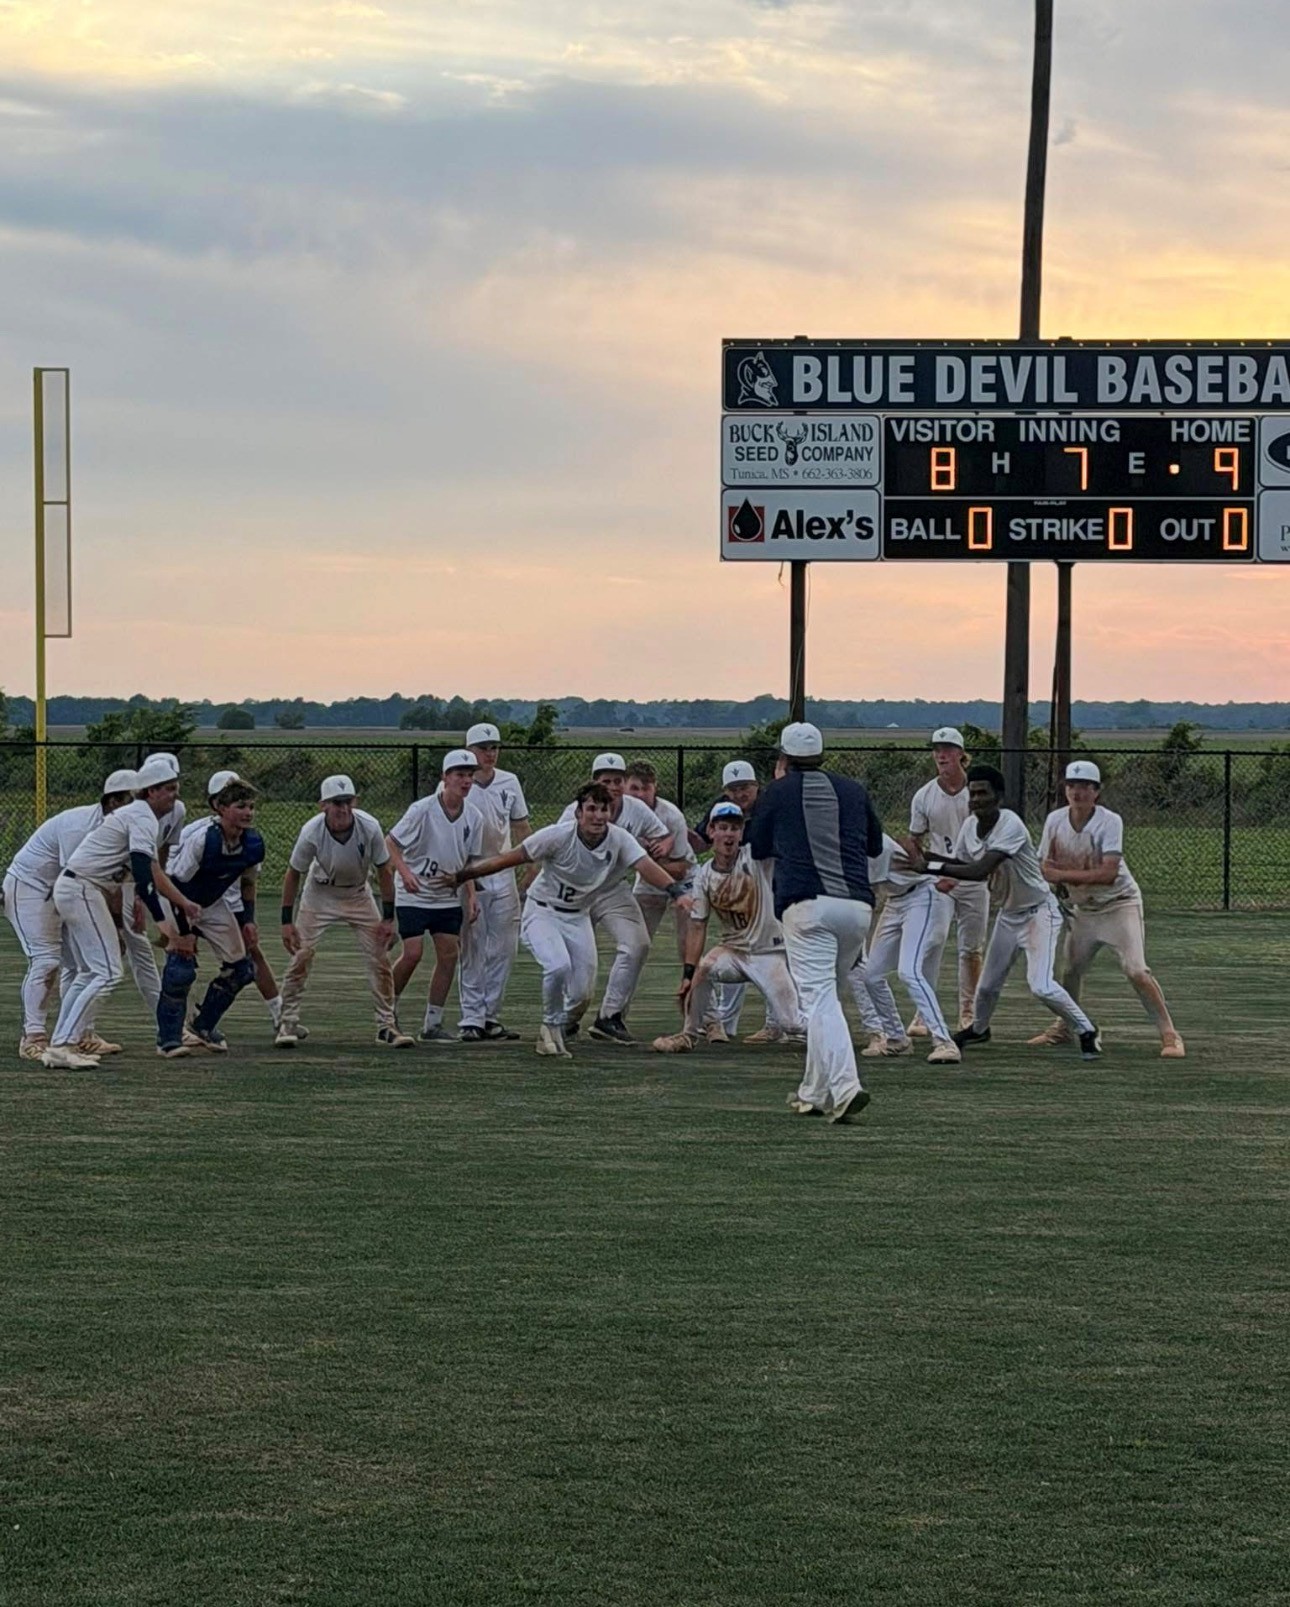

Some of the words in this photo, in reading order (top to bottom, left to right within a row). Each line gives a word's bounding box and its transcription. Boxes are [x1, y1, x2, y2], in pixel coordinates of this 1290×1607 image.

[793, 355, 915, 403] BLUE
[936, 355, 1078, 403] DEVIL
[1097, 355, 1290, 403] BASEBA
[729, 423, 775, 443] BUCK
[811, 423, 874, 443] ISLAND
[890, 420, 995, 442] VISITOR
[1019, 420, 1120, 442] INNING
[1171, 420, 1250, 442] HOME
[735, 446, 779, 462] SEED
[802, 446, 874, 462] COMPANY
[771, 468, 789, 480] MS
[802, 468, 873, 480] 662-363-3806
[931, 447, 956, 490] 8
[992, 452, 1010, 474] H
[1064, 447, 1088, 491] 7
[1128, 452, 1146, 474] E
[1214, 447, 1239, 491] 9
[771, 509, 874, 540] Alex's
[890, 518, 961, 540] BALL
[968, 506, 993, 550] 0
[1009, 518, 1104, 541] STRIKE
[1108, 507, 1133, 550] 0
[1159, 518, 1216, 541] OUT
[1223, 507, 1248, 550] 0
[944, 836, 953, 854] 2
[419, 857, 439, 877] 19
[556, 882, 577, 903] 12
